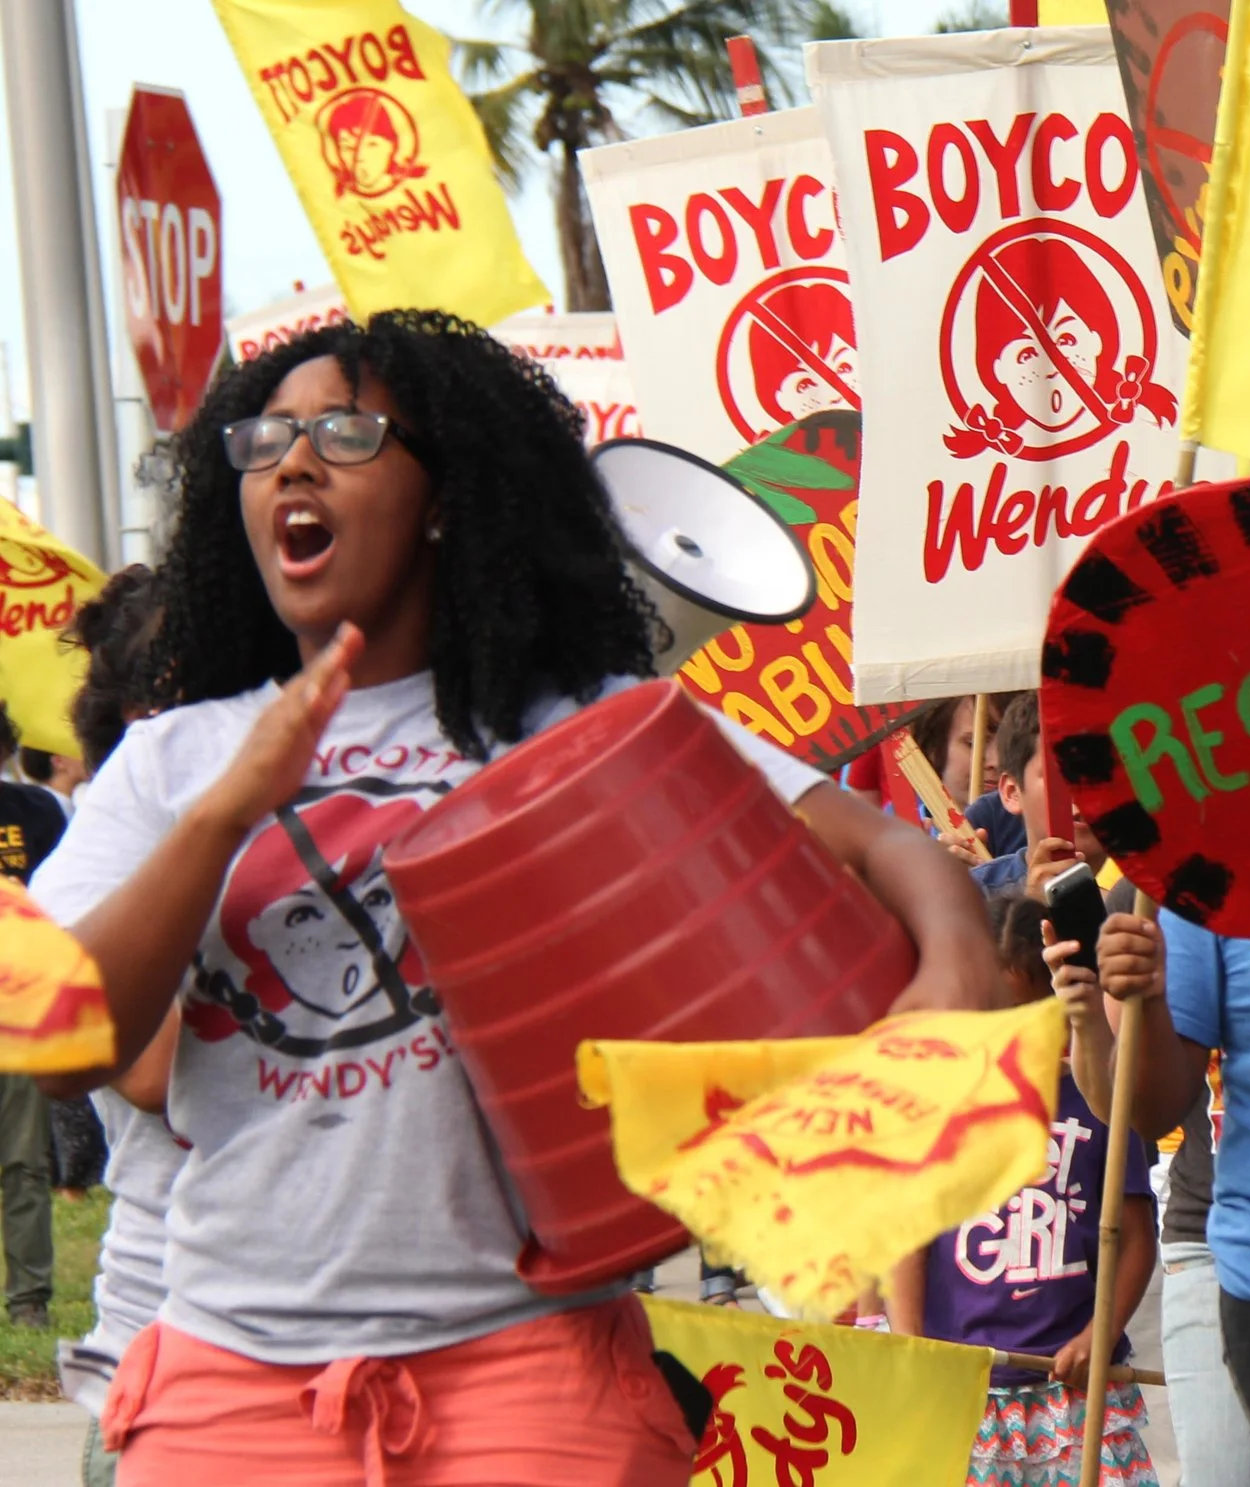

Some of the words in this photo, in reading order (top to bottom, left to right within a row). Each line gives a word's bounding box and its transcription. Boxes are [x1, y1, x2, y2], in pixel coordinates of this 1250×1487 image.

[629, 174, 835, 315] BOYC
[864, 112, 1138, 262] BOYCO
[122, 196, 217, 327] STOP
[924, 440, 1177, 584] Wend
[721, 624, 854, 747] ABU
[313, 743, 467, 777] YCOTT
[258, 1024, 455, 1103] WNDY'S!
